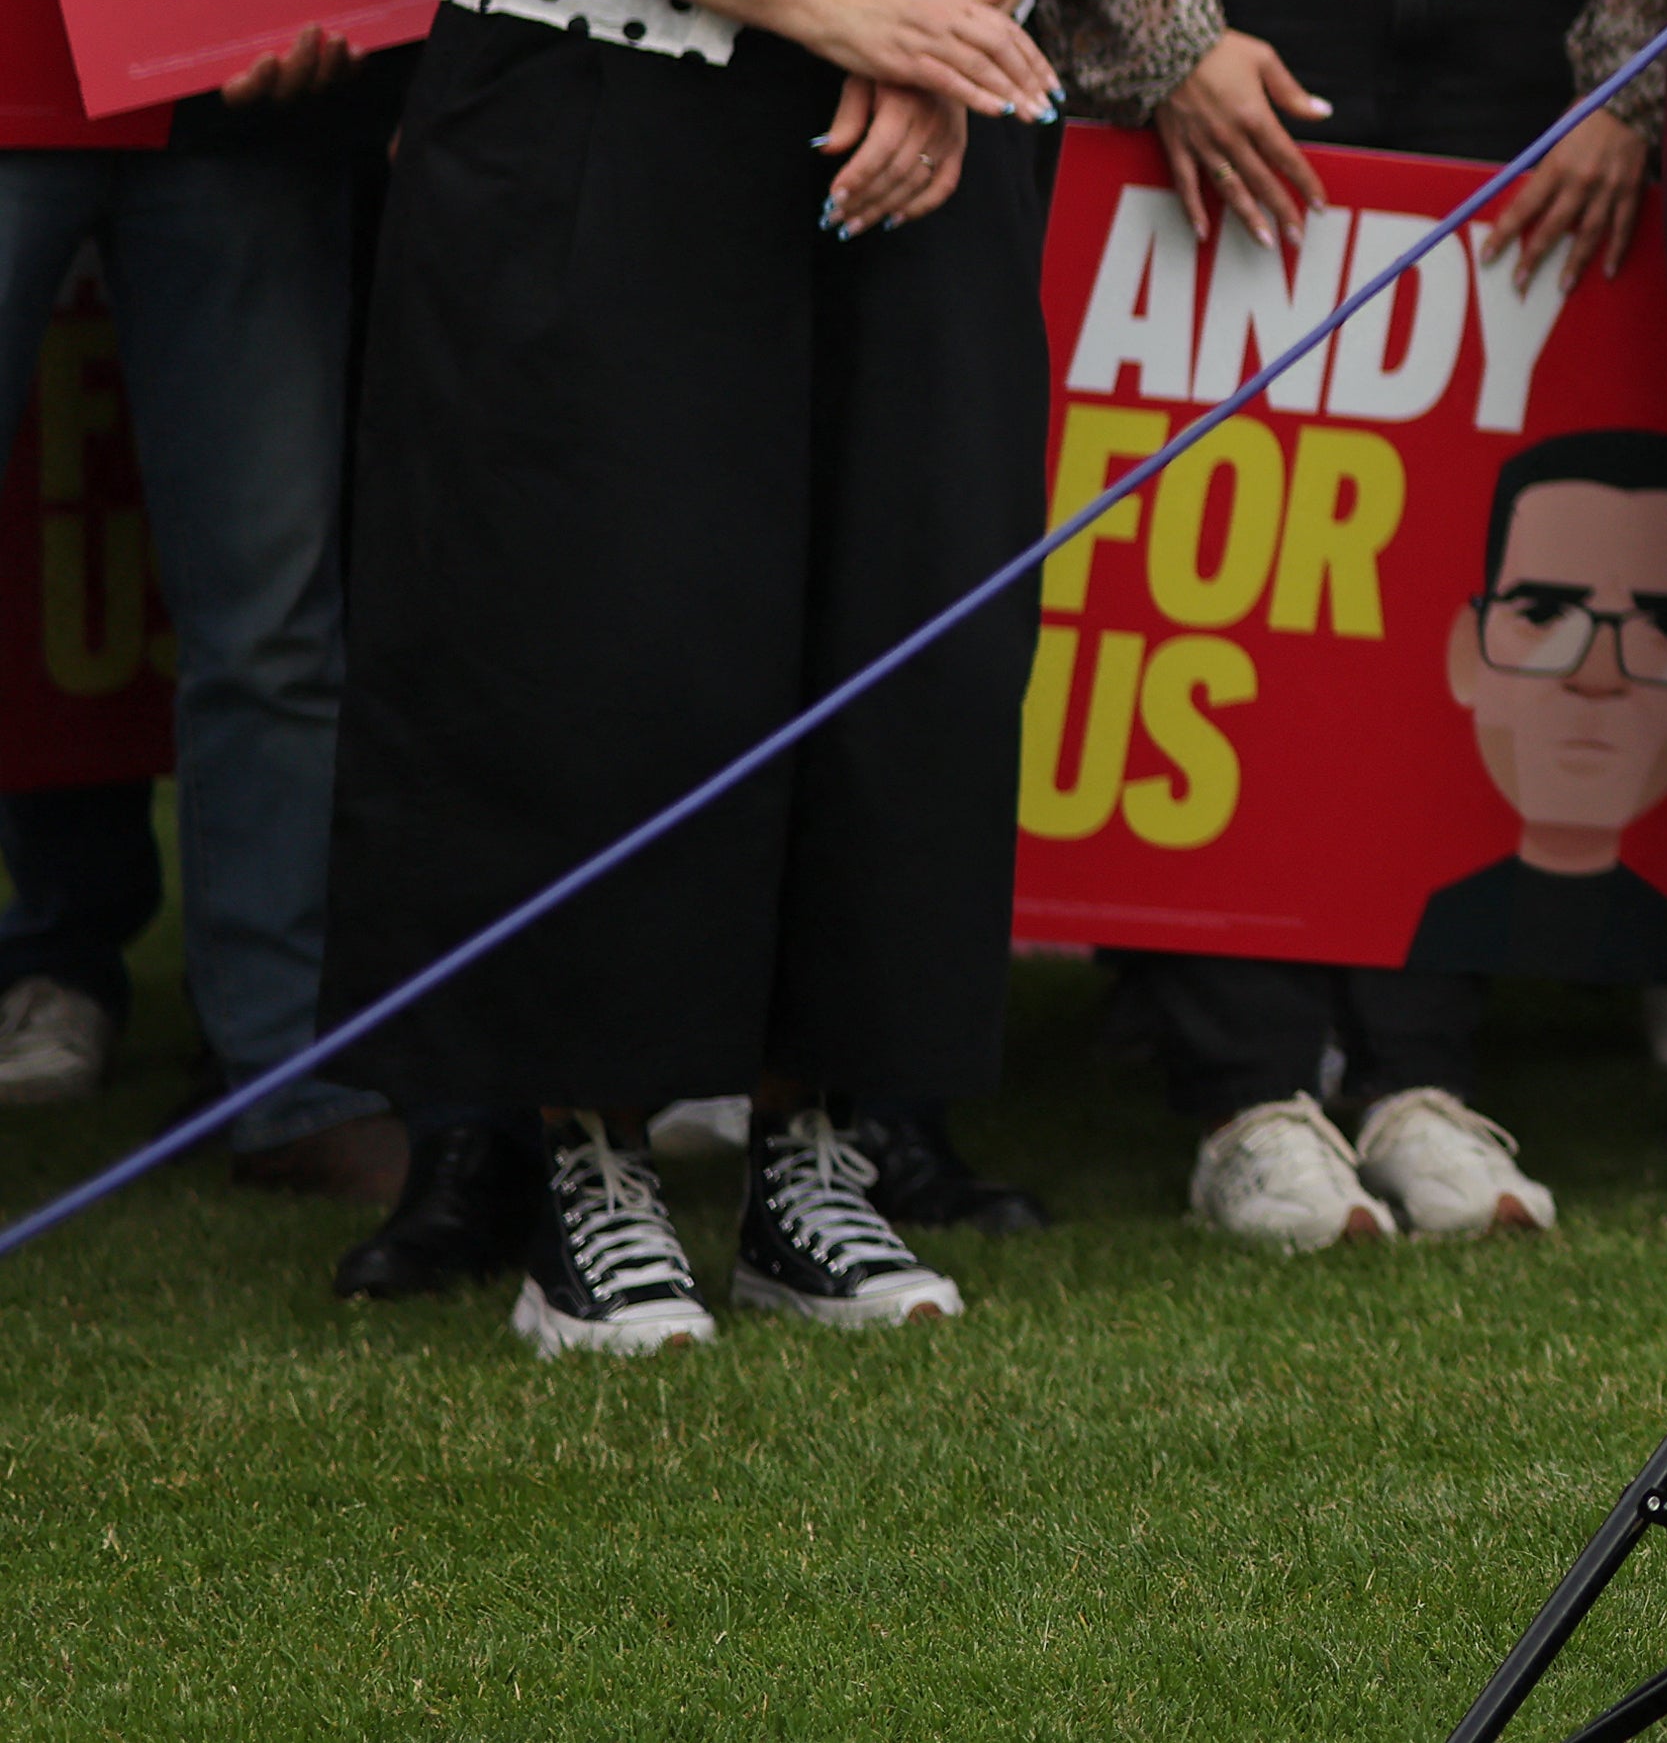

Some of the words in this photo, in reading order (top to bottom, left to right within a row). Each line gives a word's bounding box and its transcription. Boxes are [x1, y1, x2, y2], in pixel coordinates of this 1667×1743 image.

[1064, 183, 1576, 435] ANDY
[1040, 403, 1408, 641] FOR
[1017, 625, 1259, 850] US
